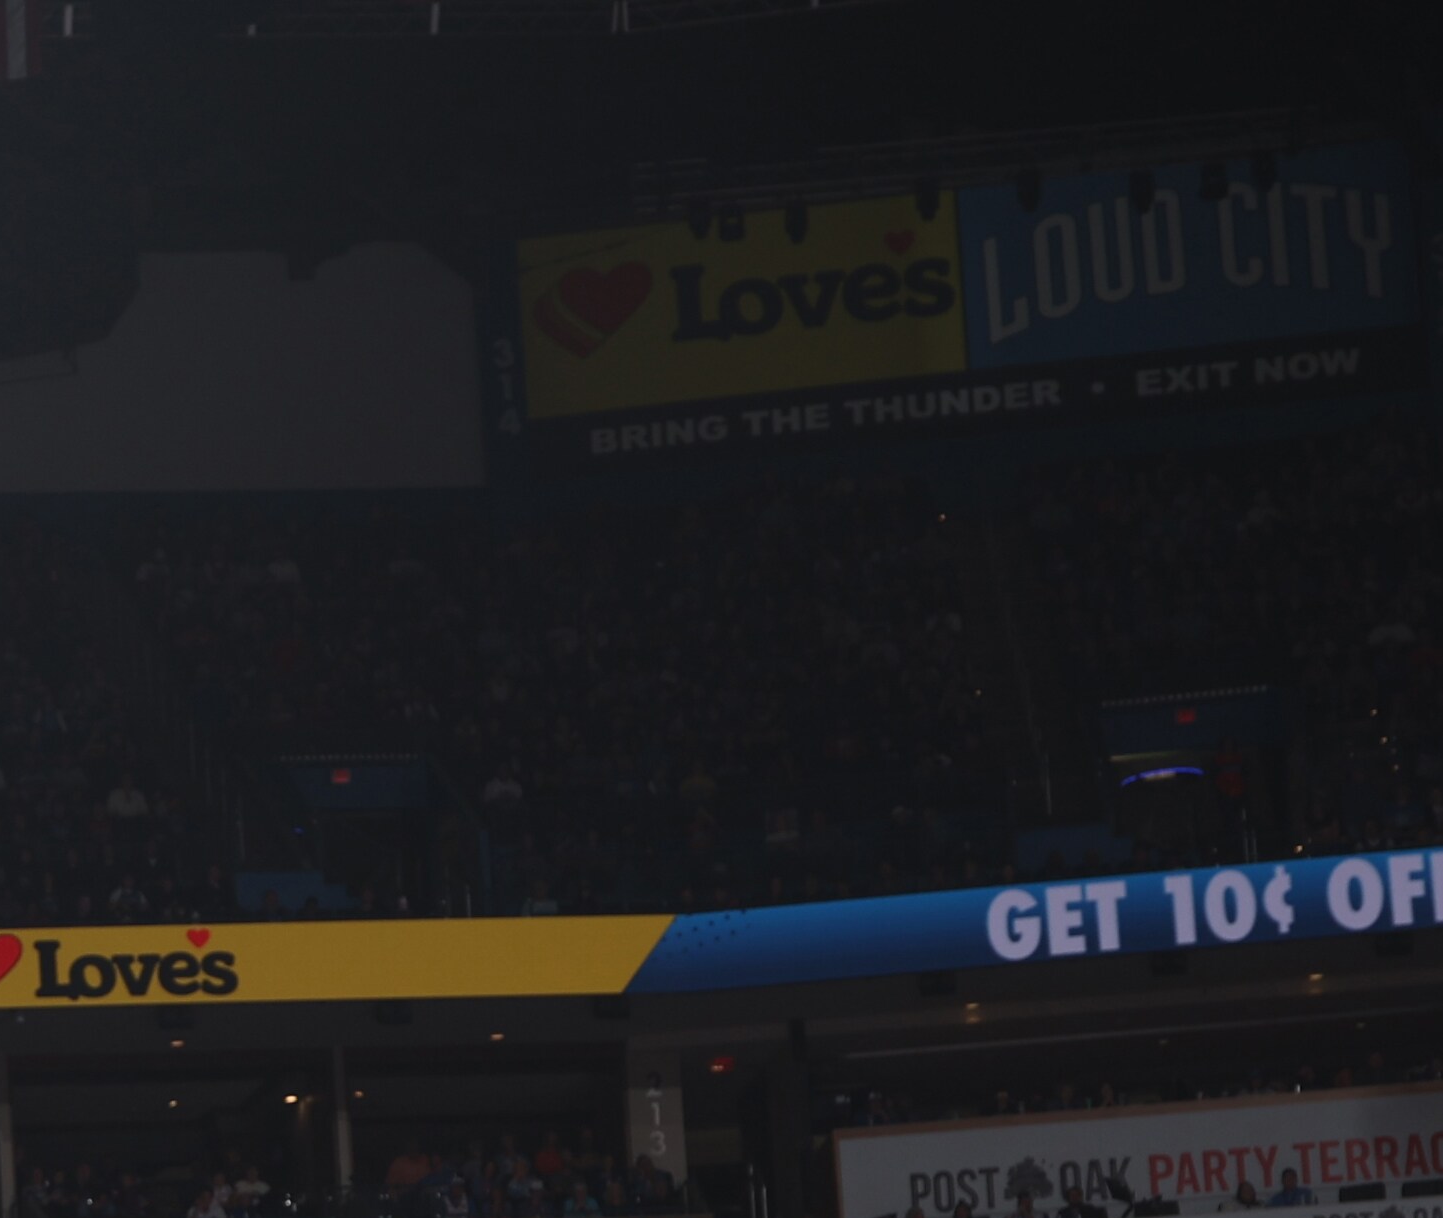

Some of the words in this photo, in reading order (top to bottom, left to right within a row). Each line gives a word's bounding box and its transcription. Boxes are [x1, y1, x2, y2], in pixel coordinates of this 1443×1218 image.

[984, 188, 1185, 345] LOUD
[1217, 180, 1393, 298] CITY
[590, 416, 728, 454] BRING
[741, 402, 830, 438] THE
[844, 378, 1061, 424] THUNDER
[1136, 360, 1240, 399] EXIT
[1253, 347, 1361, 383] NOW
[986, 879, 1127, 962] GET
[1164, 863, 1296, 946] 10¢
[909, 1166, 1000, 1215] POST
[1059, 1157, 1132, 1202] OAK
[1148, 1145, 1278, 1195] PARTY
